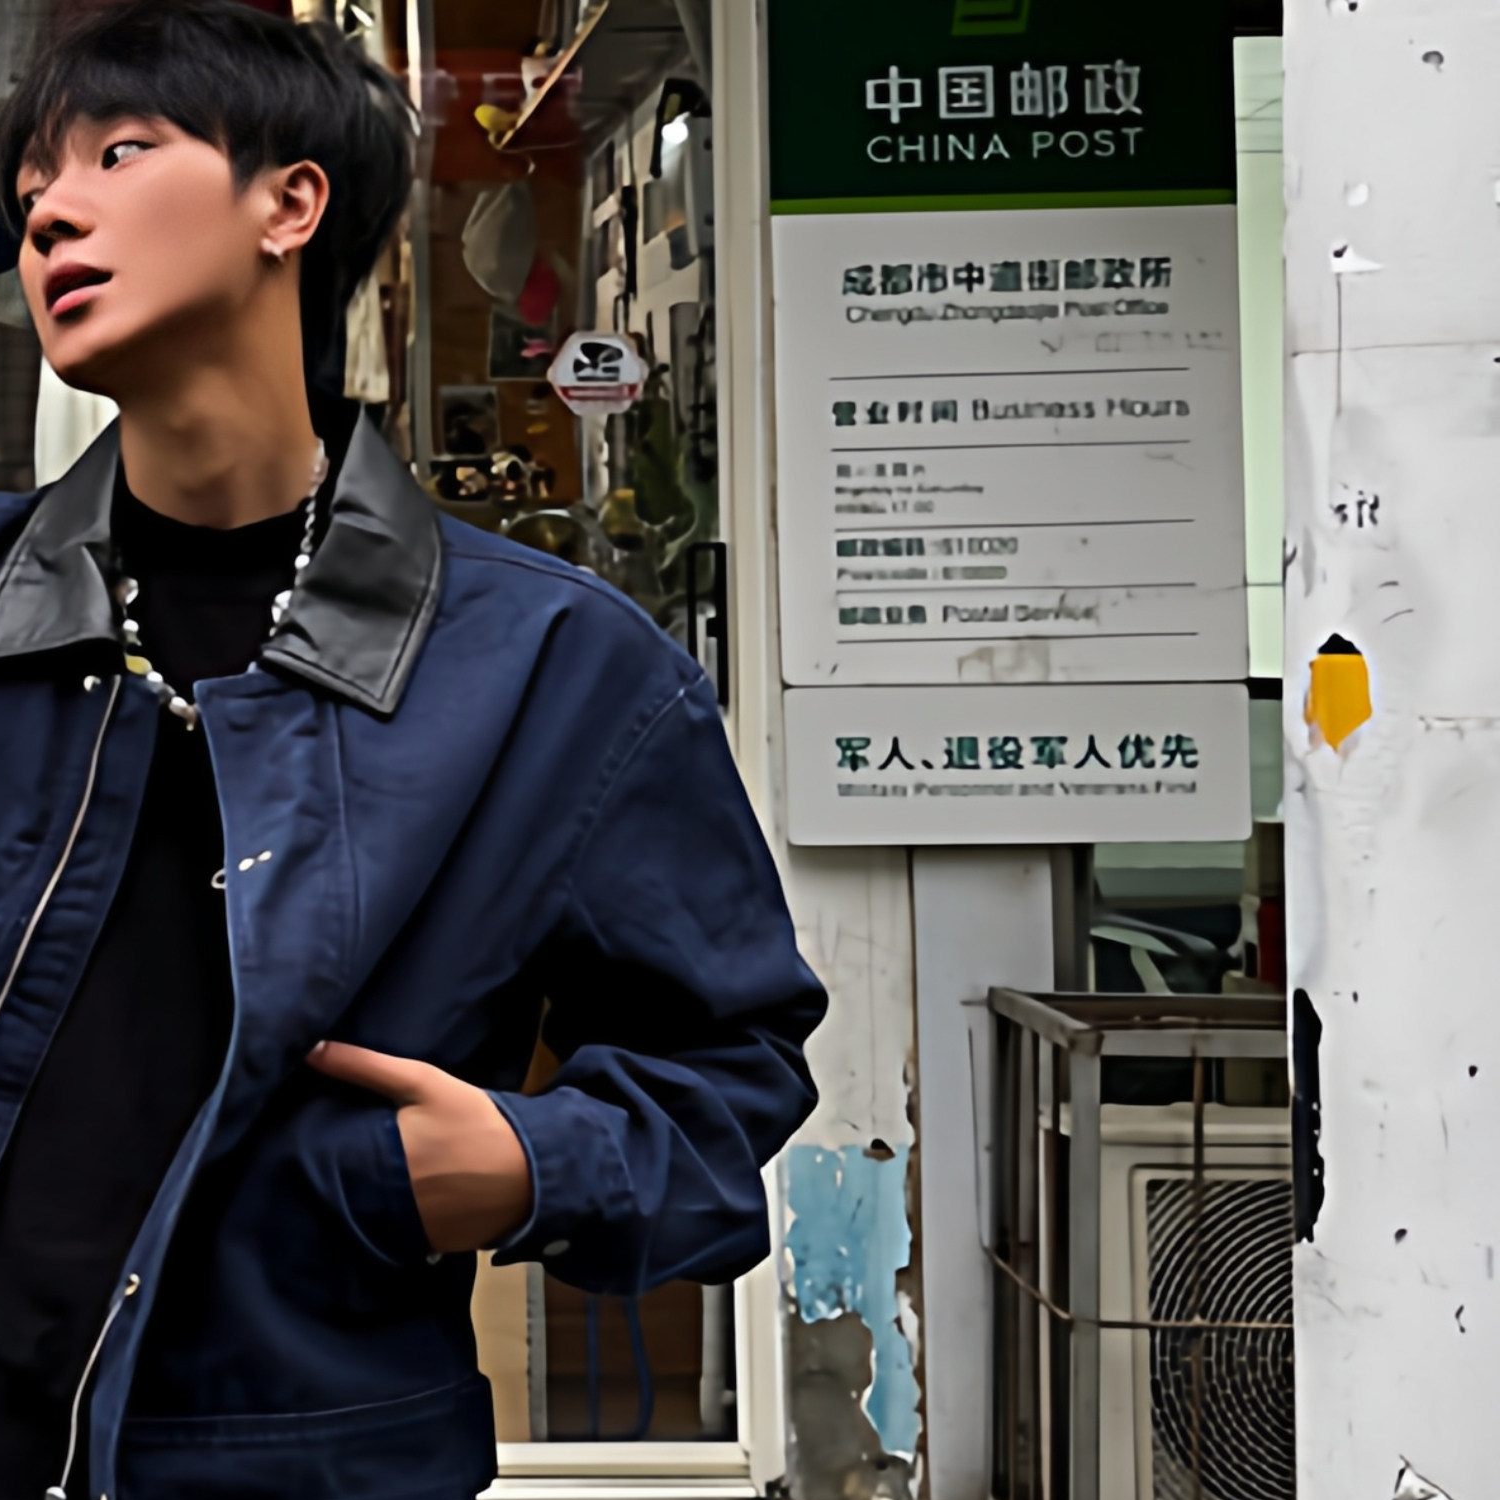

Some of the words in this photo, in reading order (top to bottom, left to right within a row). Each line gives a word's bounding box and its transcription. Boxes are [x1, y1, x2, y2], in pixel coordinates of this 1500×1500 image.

[866, 59, 1142, 124] 中国邮政
[867, 133, 1011, 163] CHINA
[1032, 127, 1143, 159] POST
[973, 398, 1096, 421] Business
[1106, 397, 1191, 418] Hours
[836, 734, 1199, 771] 军人、退役军人优先
